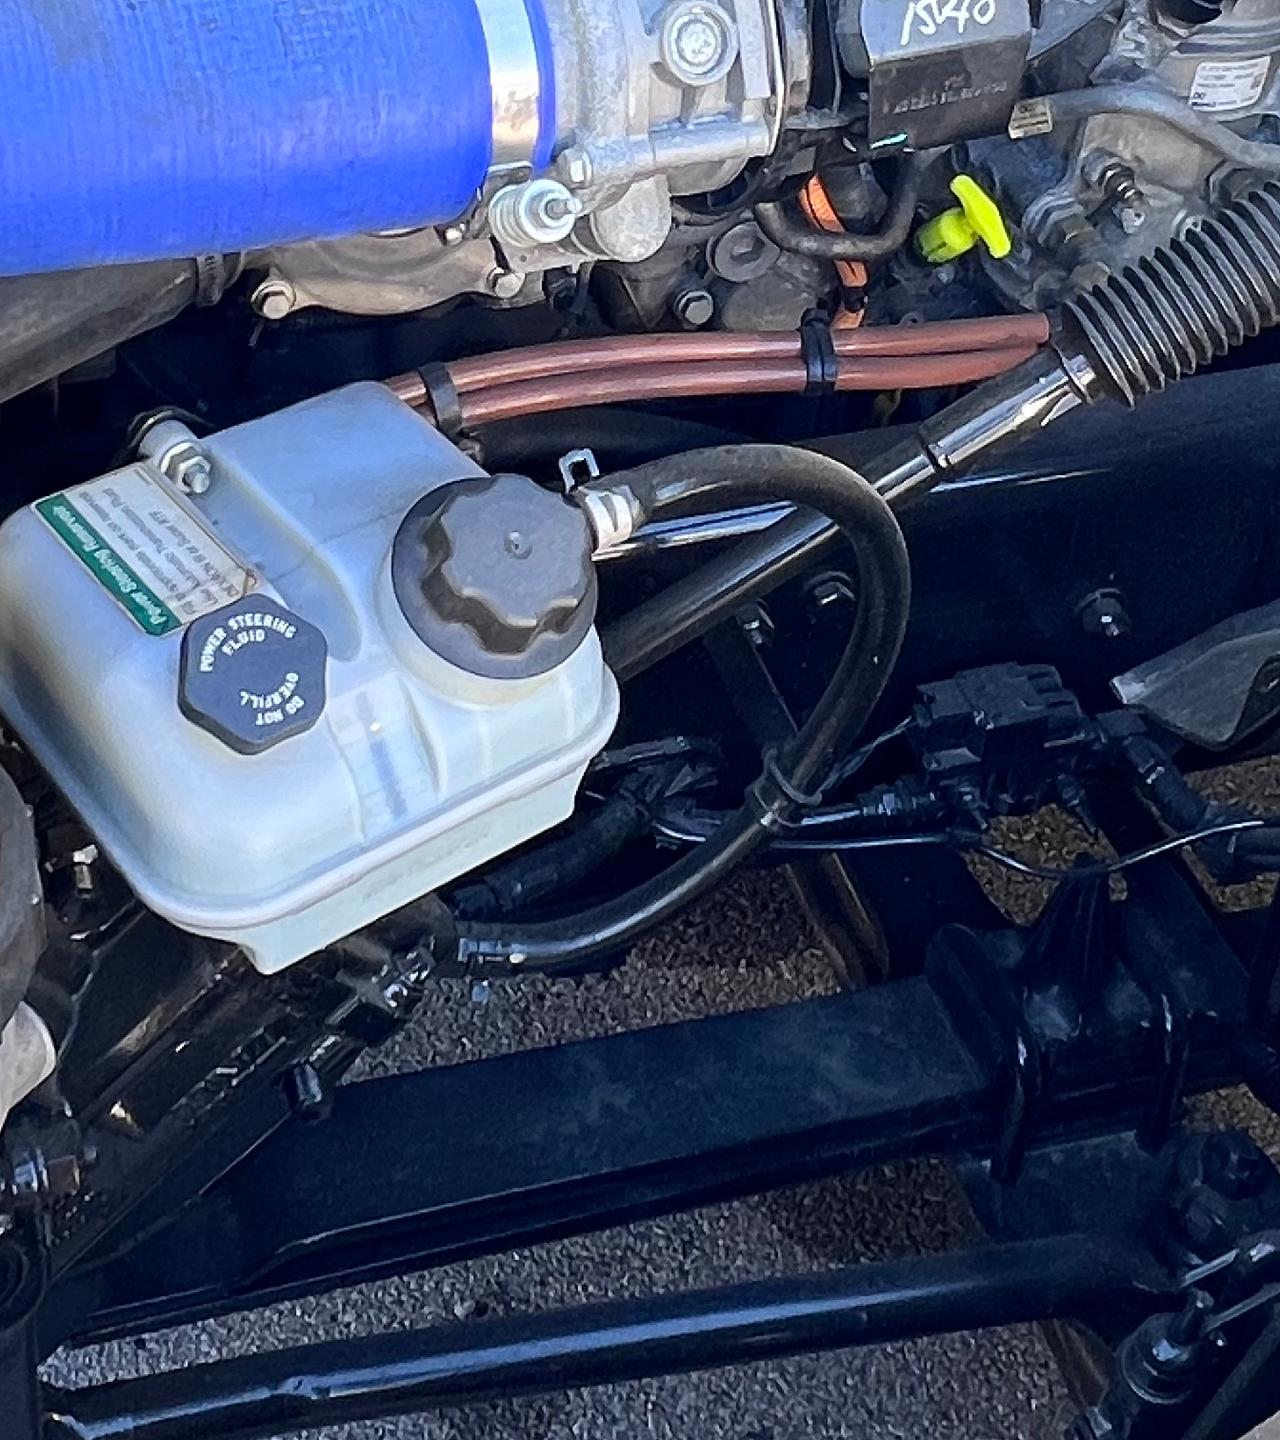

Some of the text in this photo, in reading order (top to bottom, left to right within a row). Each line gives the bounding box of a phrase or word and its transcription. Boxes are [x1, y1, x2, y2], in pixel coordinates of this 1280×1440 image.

[94, 548, 138, 592] Steering
[130, 589, 168, 625] Power
[200, 613, 297, 672] POWER STEERING
[221, 629, 266, 656] FLUID
[240, 672, 299, 709] OVERFILL
[255, 695, 305, 726] DO NOT
